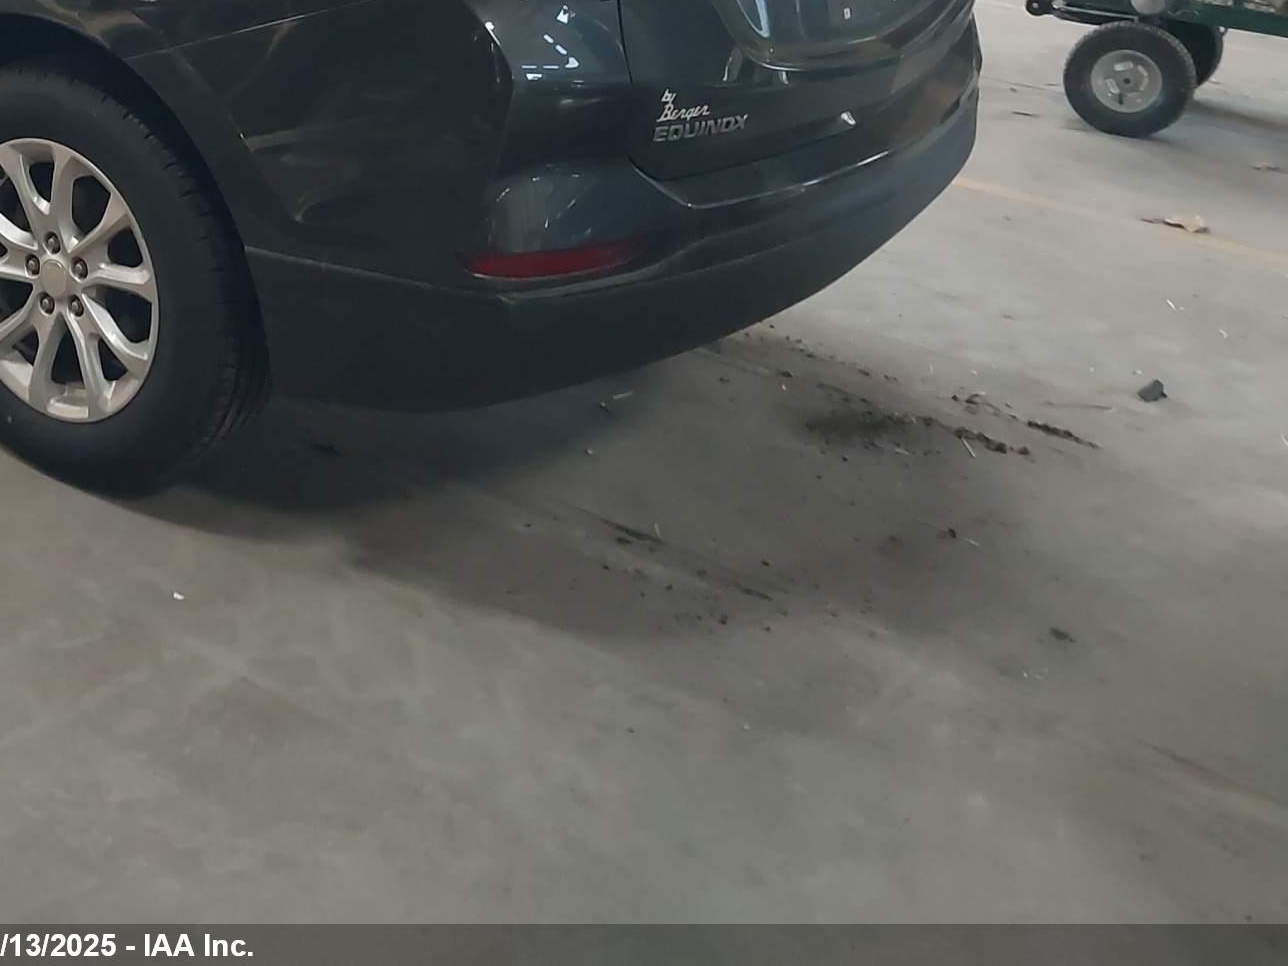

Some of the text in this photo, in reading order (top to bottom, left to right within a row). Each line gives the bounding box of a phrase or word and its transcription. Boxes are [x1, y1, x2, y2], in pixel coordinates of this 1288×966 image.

[661, 88, 677, 106] by
[656, 103, 711, 123] Berger
[653, 113, 749, 142] EQUINOX
